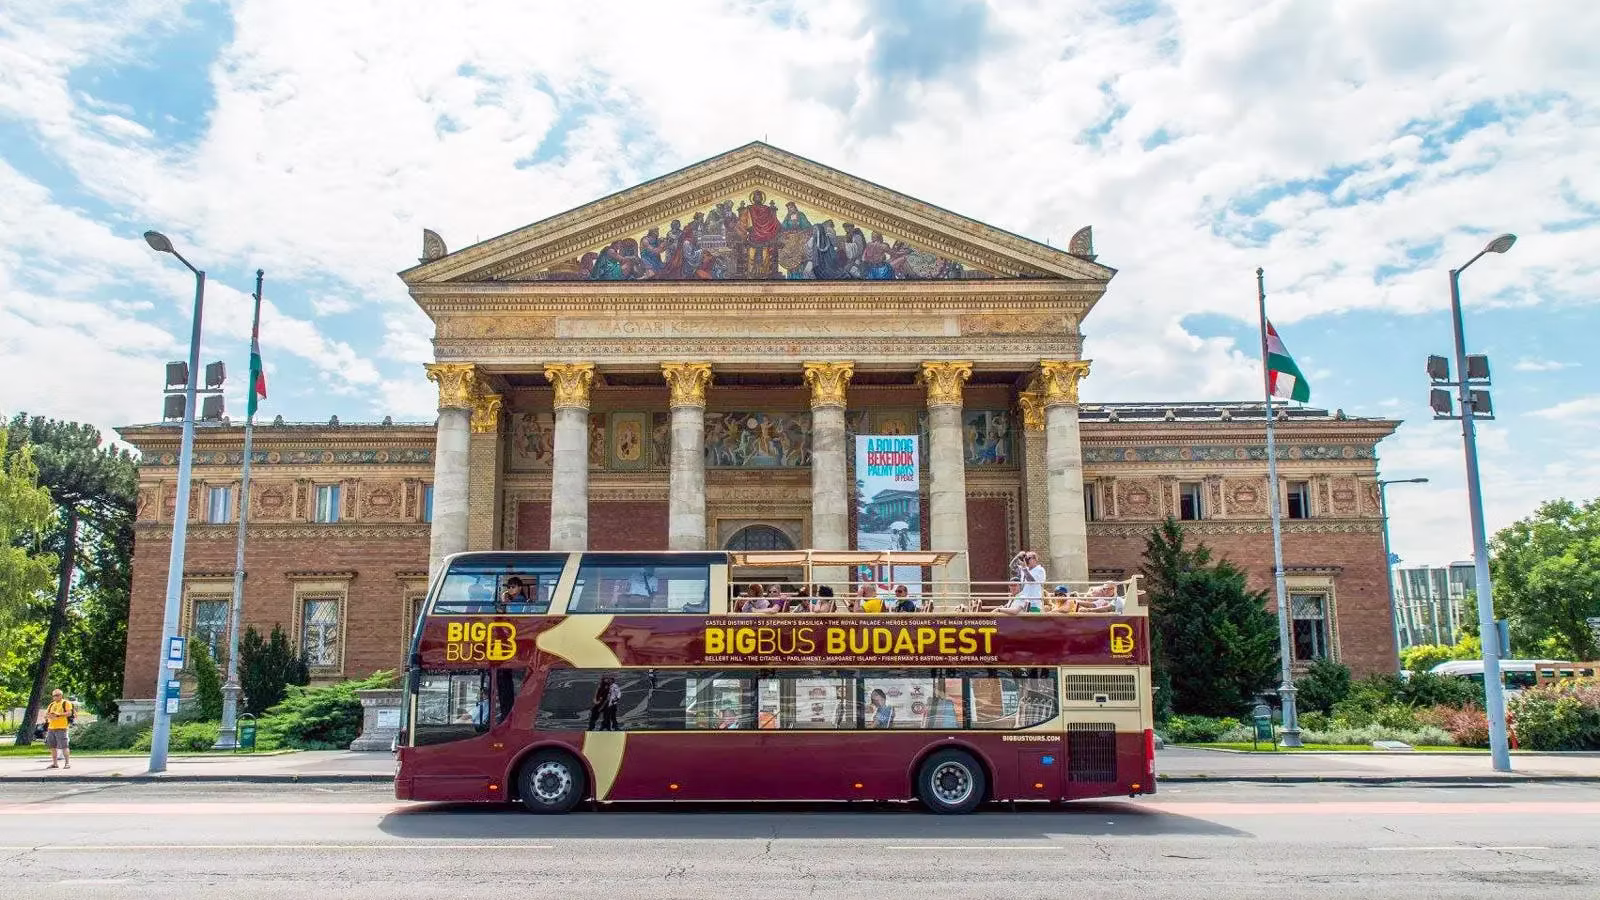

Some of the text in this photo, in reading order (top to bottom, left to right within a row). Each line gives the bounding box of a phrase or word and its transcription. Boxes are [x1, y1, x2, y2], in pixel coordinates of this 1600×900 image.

[867, 465, 914, 476] PALMY DAYS
[447, 622, 487, 642] BIG
[826, 627, 998, 654] BUDAPEST
[446, 643, 486, 660] BUS
[1002, 734, 1061, 742] BIGBUSTOURS.COM
